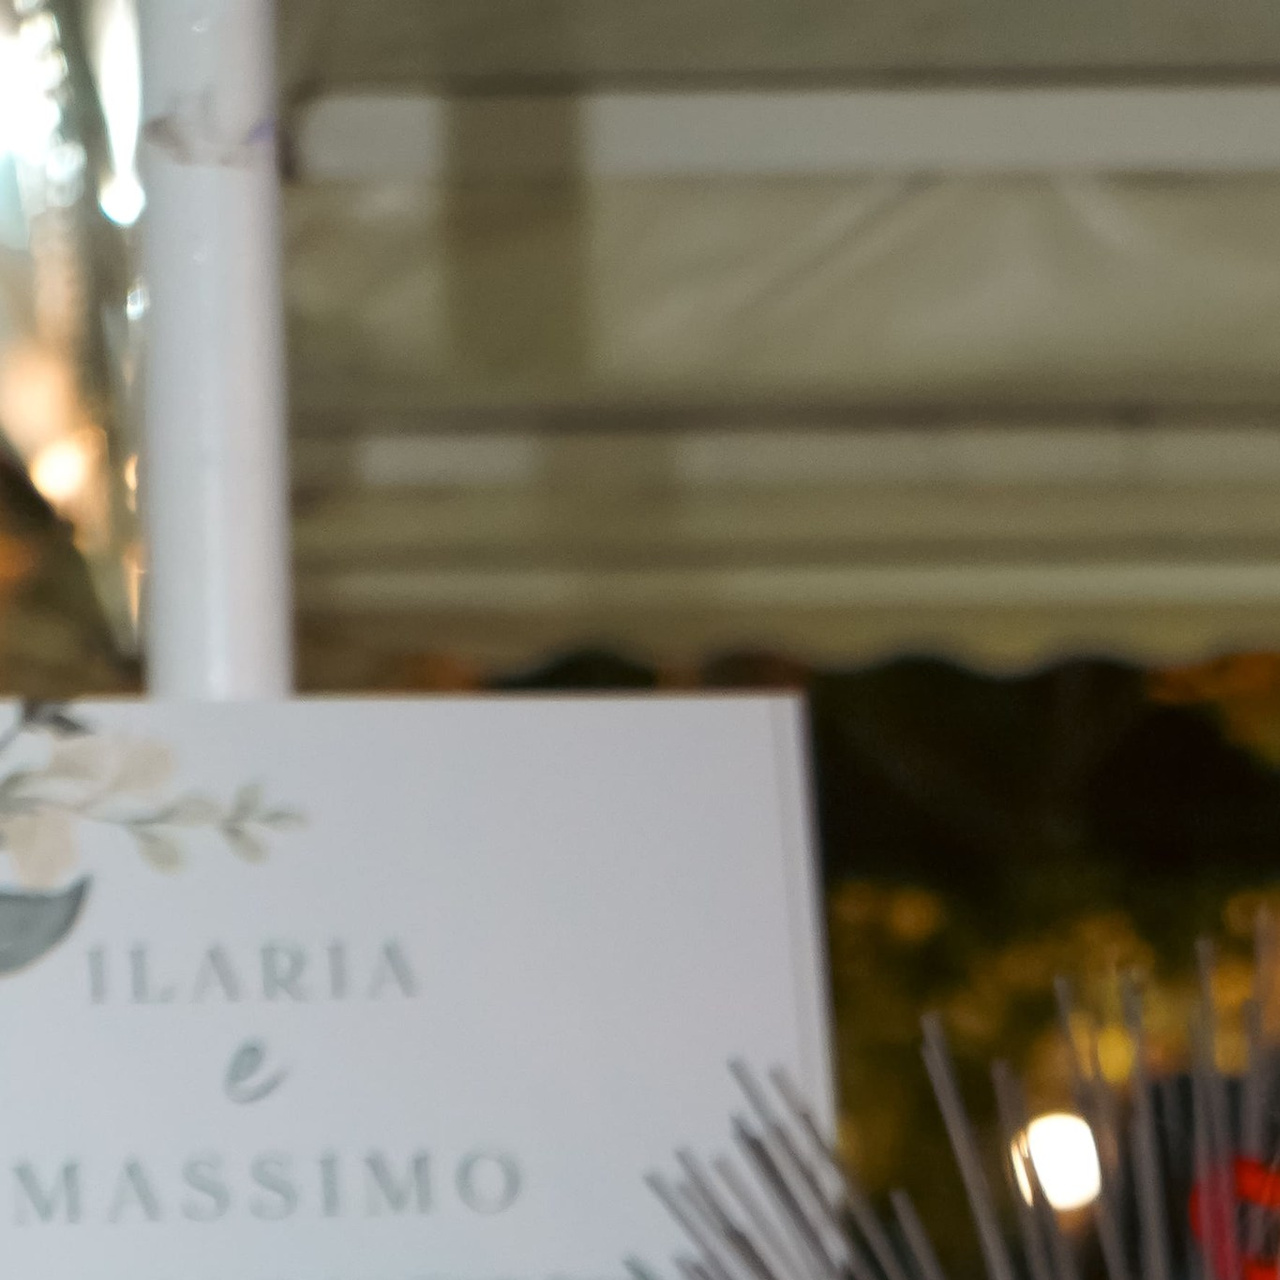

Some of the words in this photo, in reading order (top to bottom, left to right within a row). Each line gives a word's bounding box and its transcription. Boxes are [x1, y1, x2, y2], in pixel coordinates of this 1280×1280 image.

[86, 936, 421, 1005] ILARIA
[223, 1037, 289, 1105] e
[10, 1148, 525, 1226] MASSIMO
